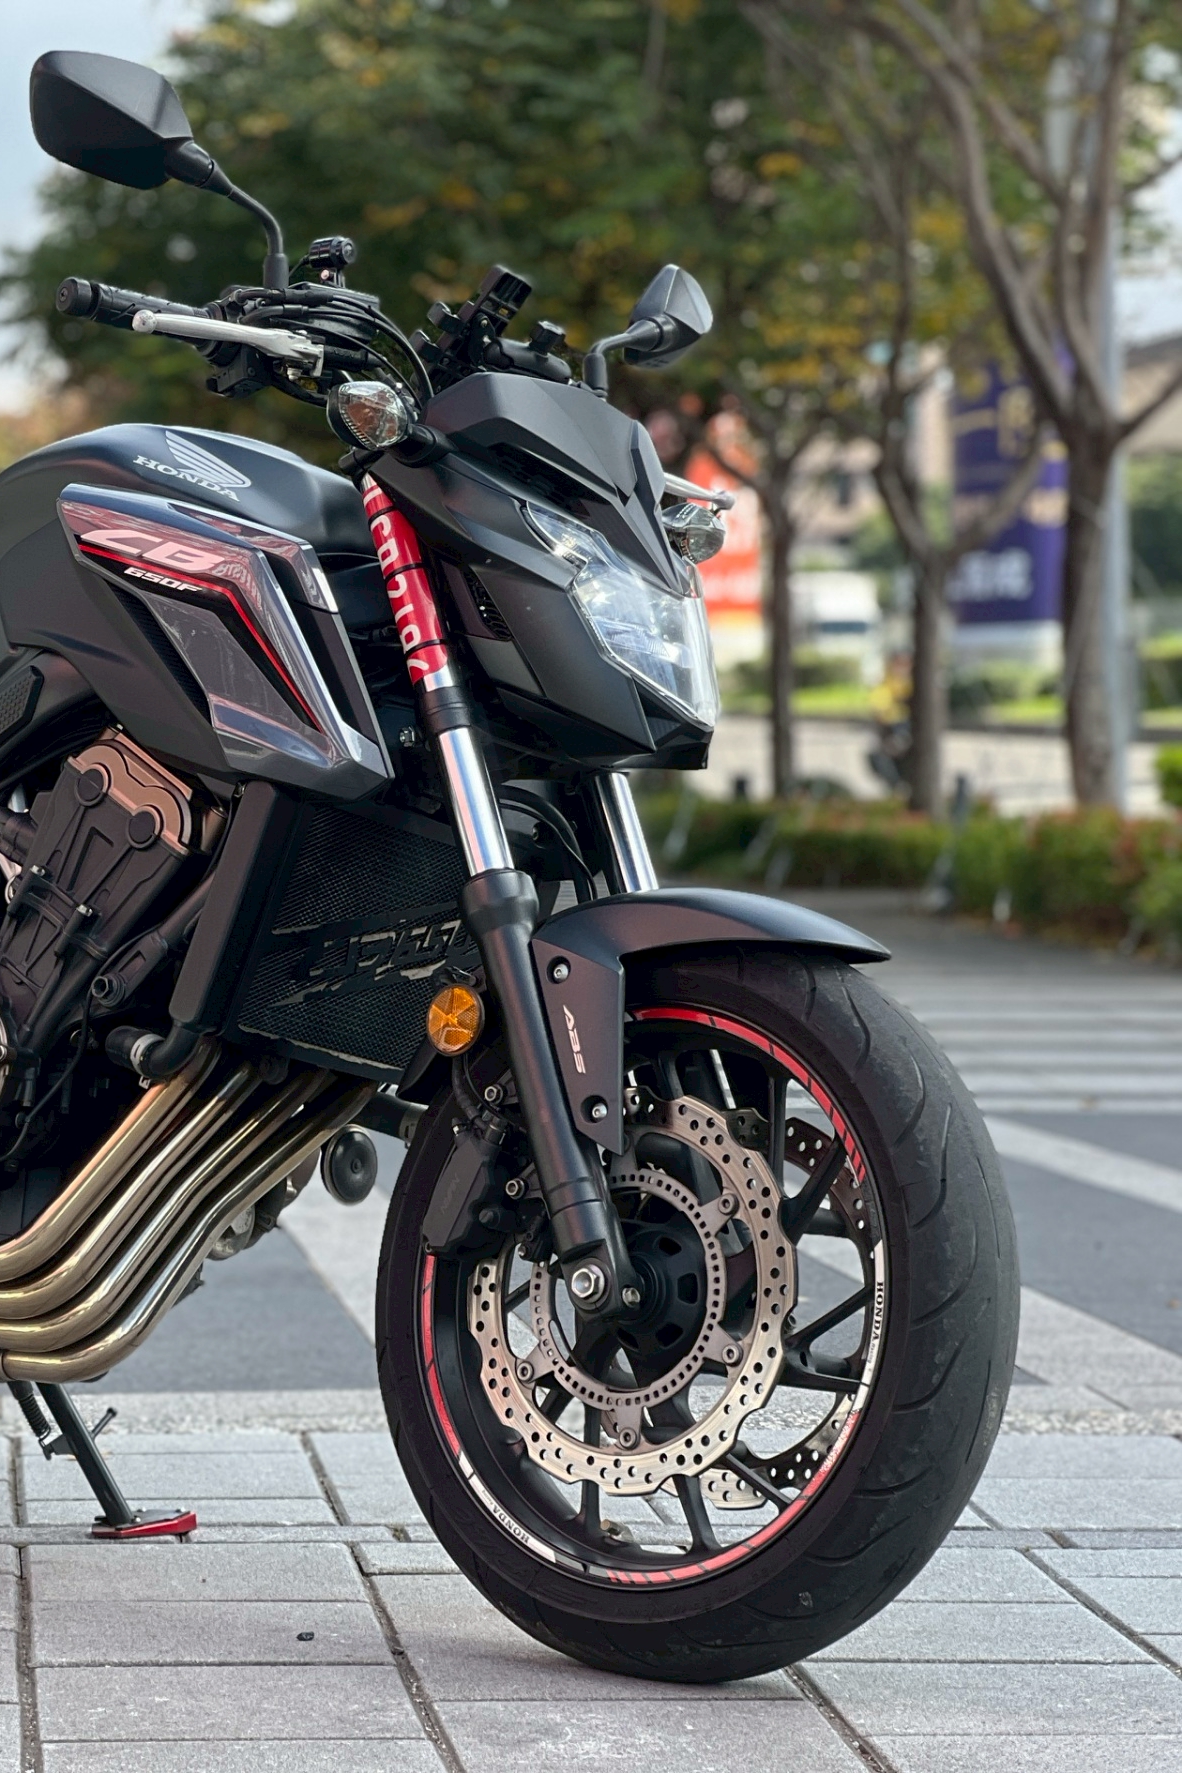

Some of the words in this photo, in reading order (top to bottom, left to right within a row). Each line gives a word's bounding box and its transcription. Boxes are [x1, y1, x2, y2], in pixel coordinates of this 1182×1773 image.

[133, 455, 240, 501] HONDA
[80, 530, 225, 571] CB
[124, 567, 203, 592] 650F
[563, 1005, 586, 1073] ABS
[870, 1281, 884, 1340] HONDA
[492, 1504, 530, 1544] HONDA
